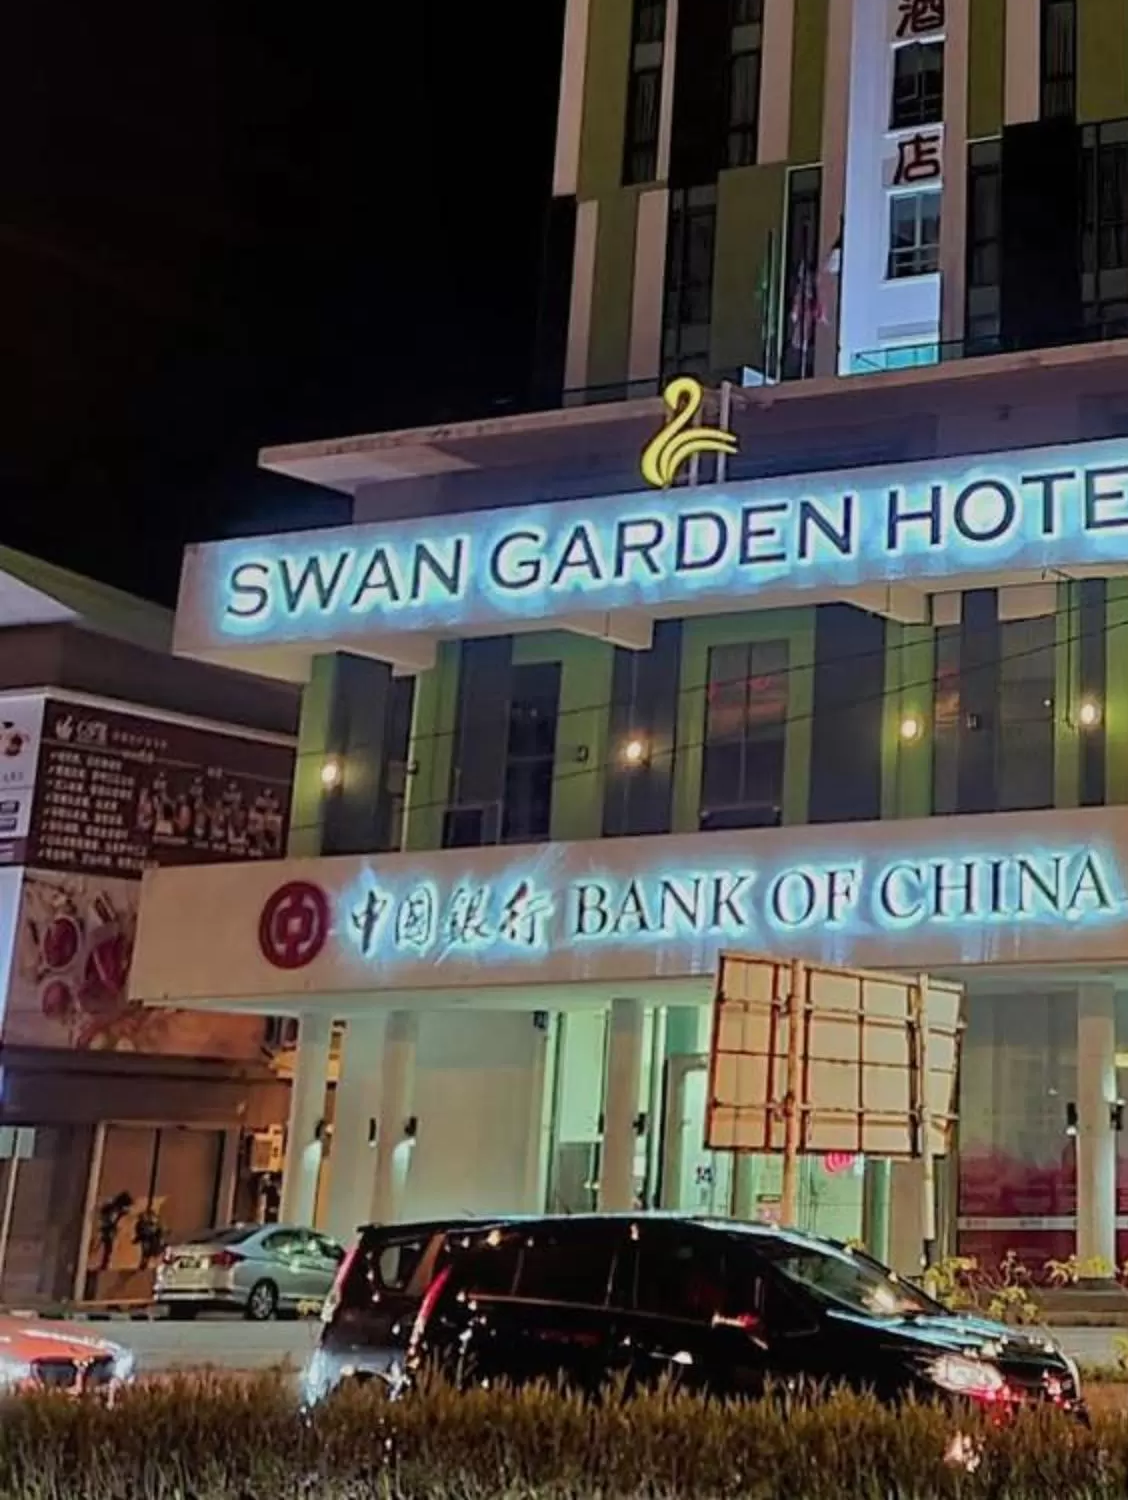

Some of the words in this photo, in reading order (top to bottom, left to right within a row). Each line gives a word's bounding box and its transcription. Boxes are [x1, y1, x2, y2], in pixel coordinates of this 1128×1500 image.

[226, 537, 463, 618] SWAN
[490, 496, 854, 589] GARDEN
[575, 875, 751, 935] BANK
[771, 868, 857, 925] OF
[880, 852, 1115, 919] CHINA
